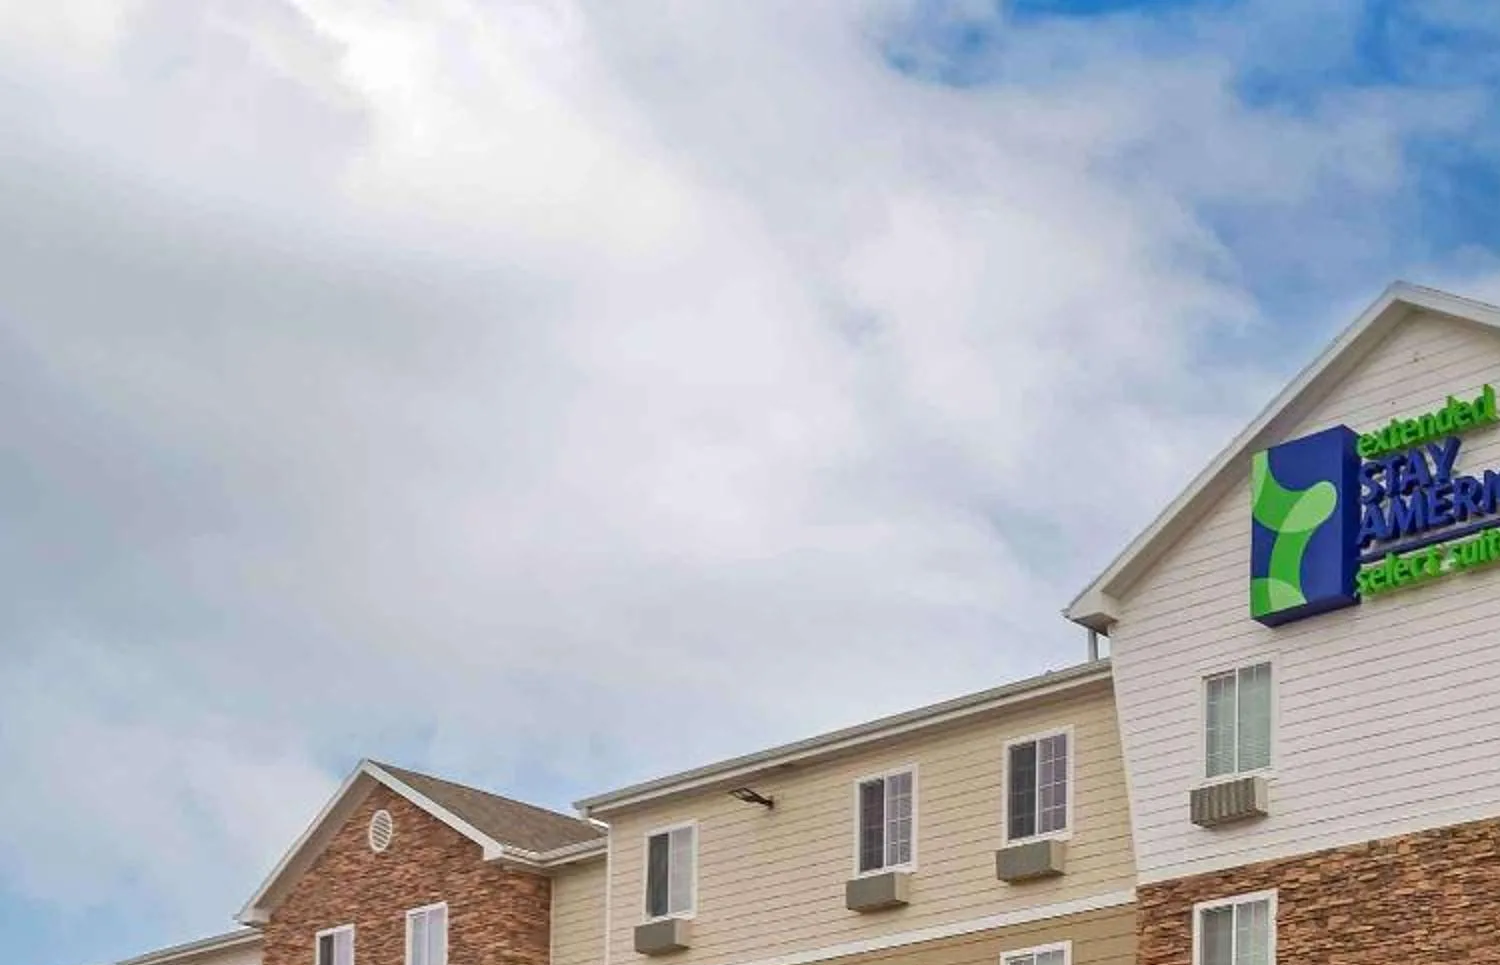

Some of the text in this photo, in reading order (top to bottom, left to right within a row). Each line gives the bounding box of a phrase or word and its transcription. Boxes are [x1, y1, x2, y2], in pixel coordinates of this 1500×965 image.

[1358, 384, 1500, 457] extended
[1359, 436, 1462, 502] STAY
[1356, 544, 1443, 595] select
